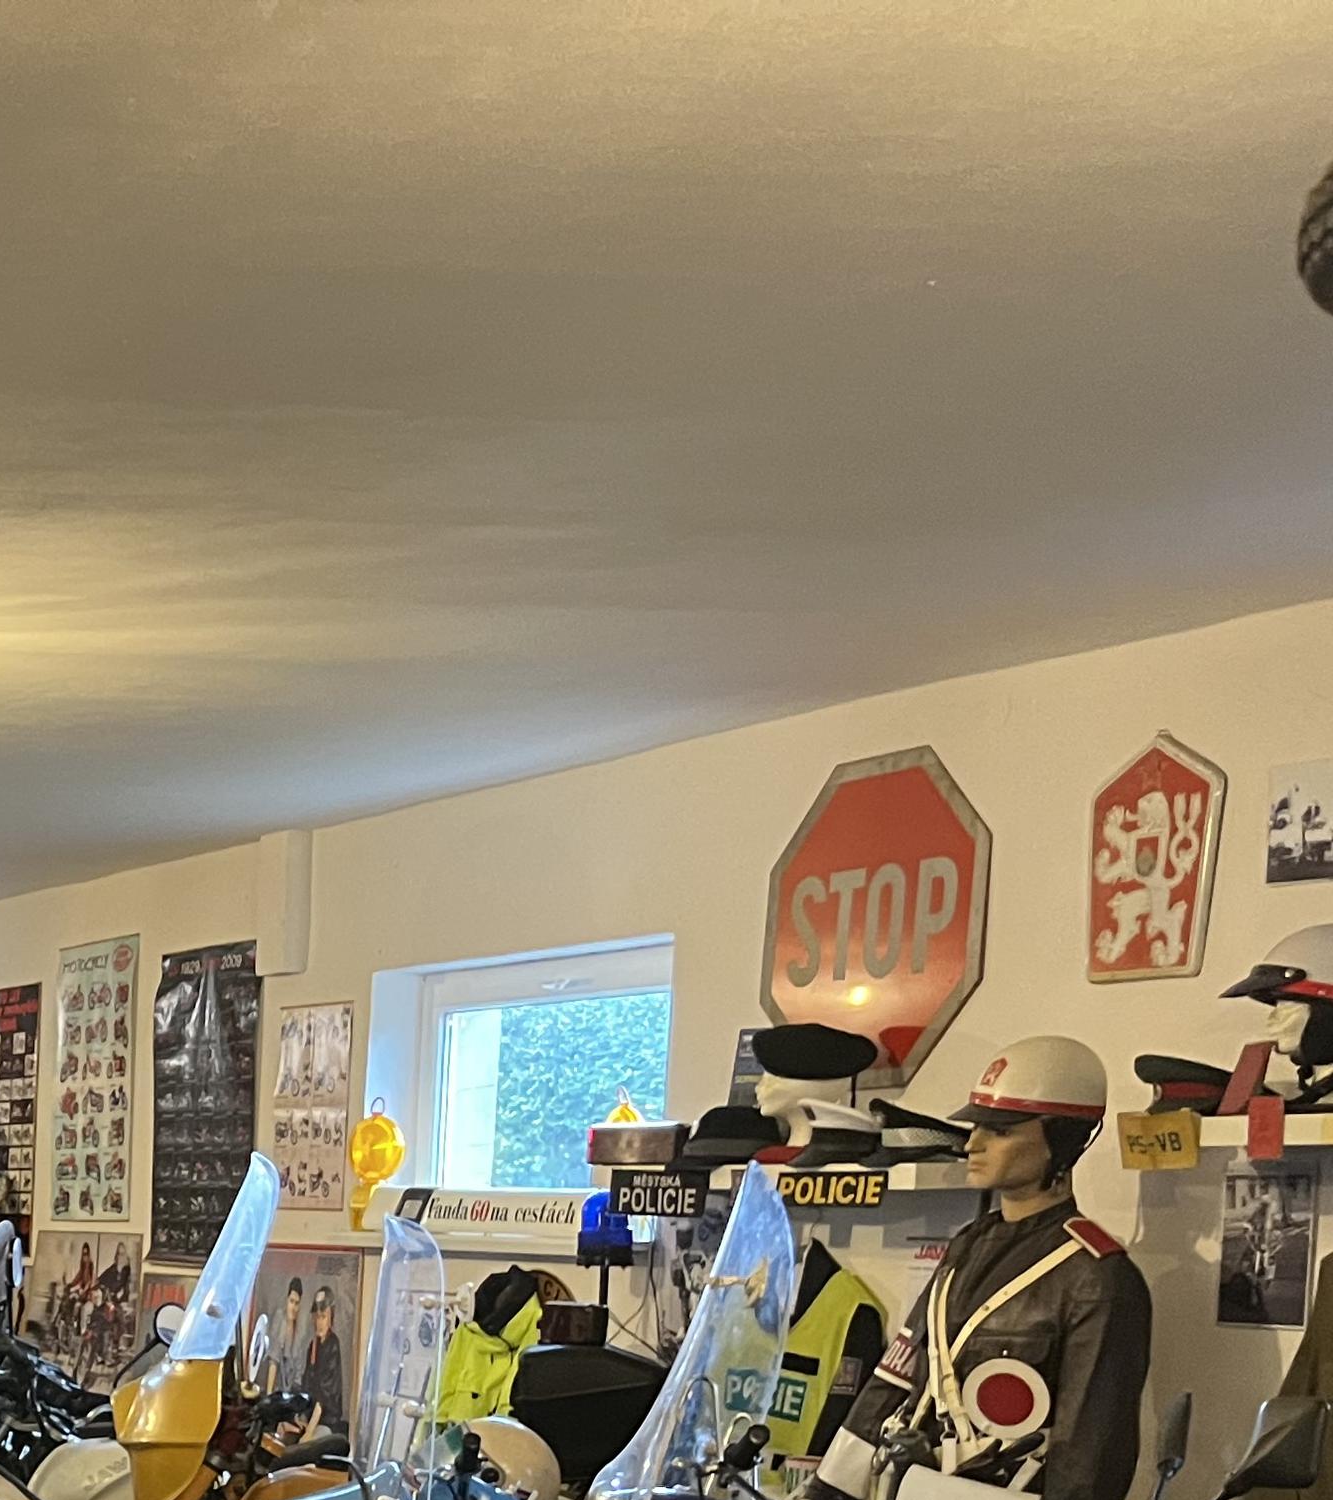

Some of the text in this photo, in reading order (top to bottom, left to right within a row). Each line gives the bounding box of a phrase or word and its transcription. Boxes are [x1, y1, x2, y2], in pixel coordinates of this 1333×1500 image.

[786, 856, 959, 988] STOP
[221, 953, 243, 970] 2009
[633, 1172, 681, 1188] MĚSTSKÁ
[780, 1174, 884, 1206] POLICIE
[469, 1200, 490, 1222] 60
[490, 1208, 509, 1223] na
[514, 1201, 576, 1225] cestách
[618, 1186, 697, 1214] POLICIE
